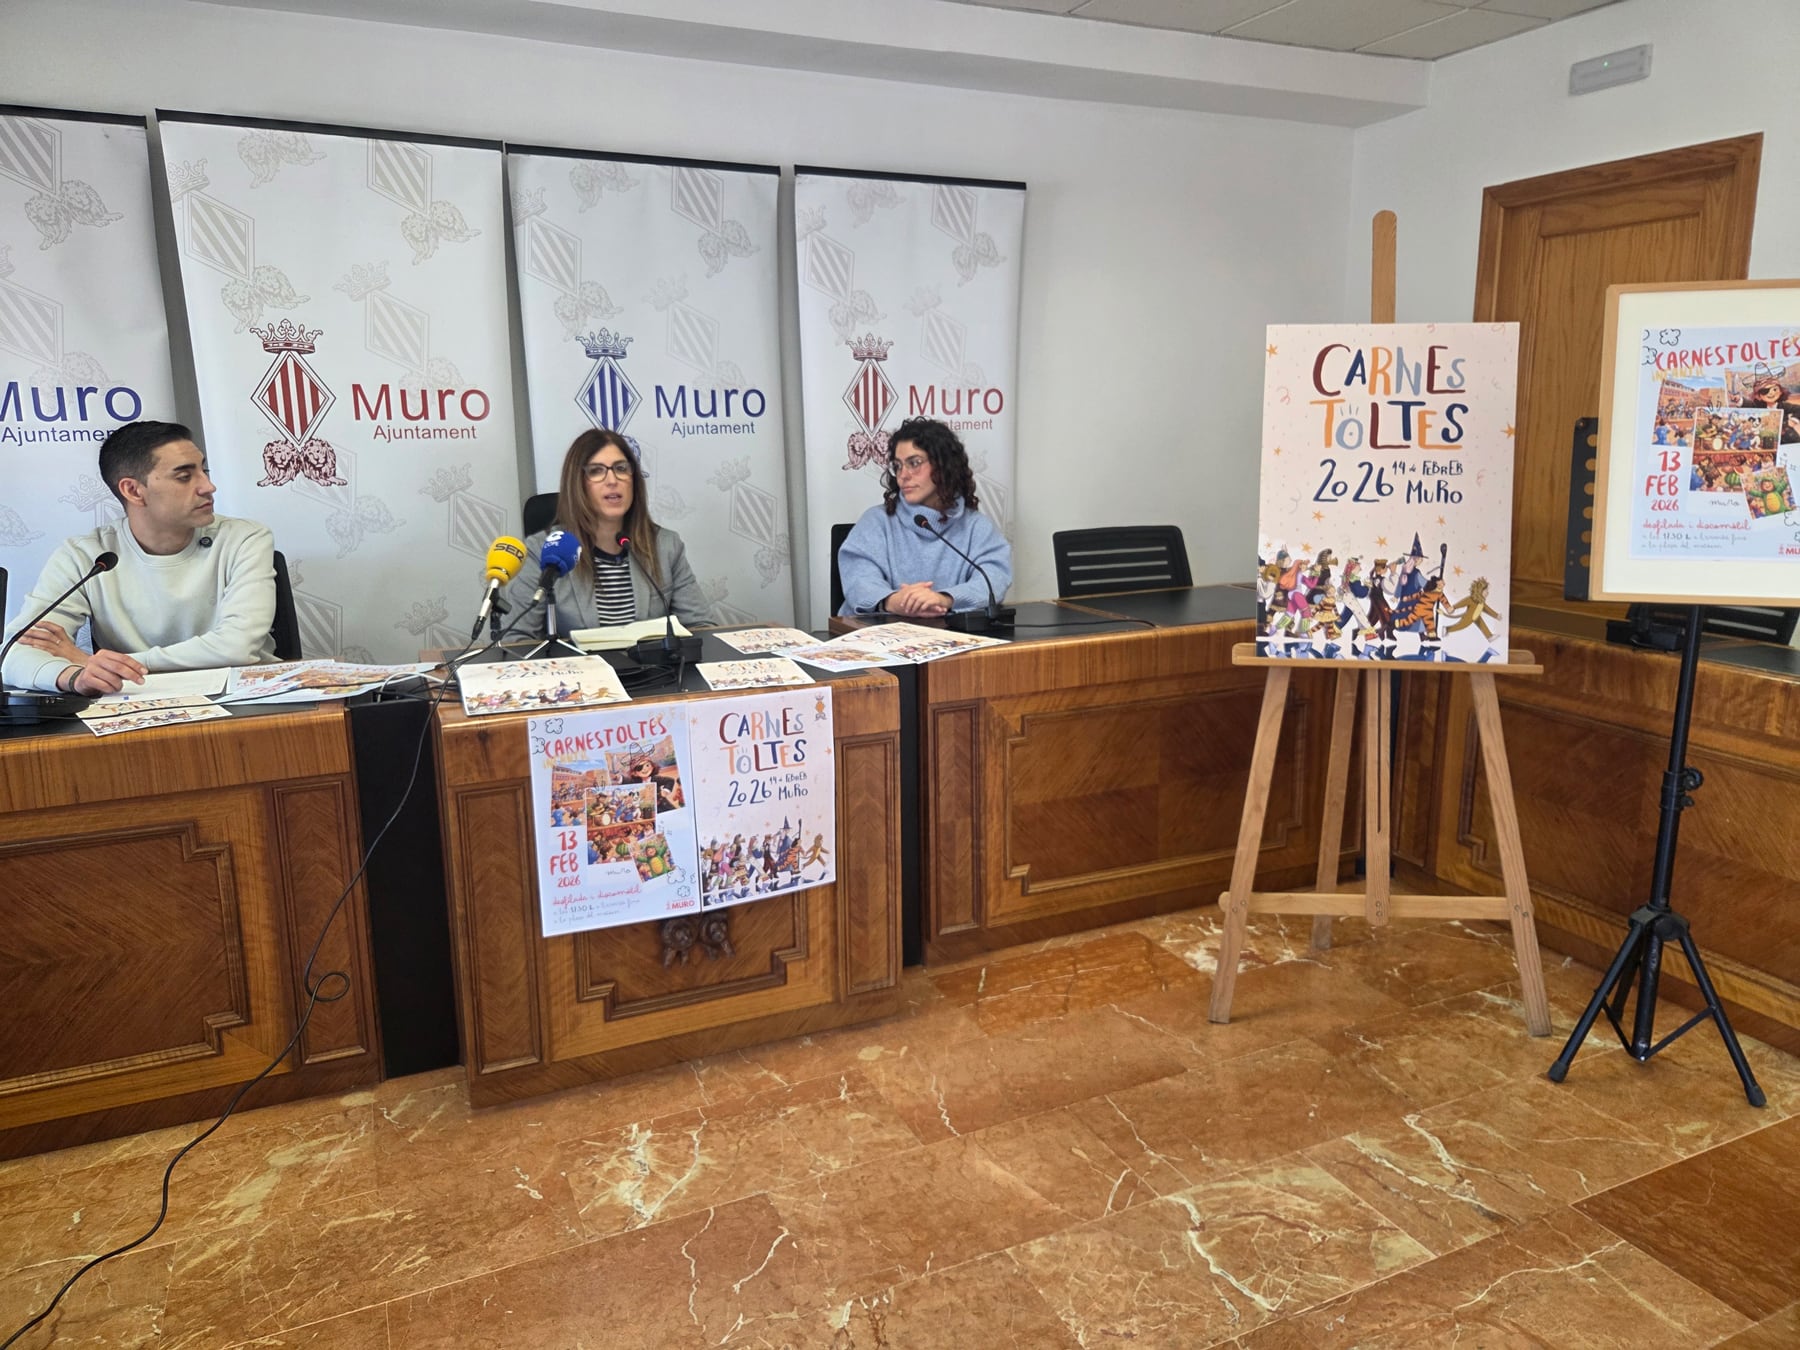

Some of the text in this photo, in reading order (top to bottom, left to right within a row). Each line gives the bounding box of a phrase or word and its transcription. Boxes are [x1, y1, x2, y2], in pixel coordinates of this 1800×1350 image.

[1312, 343, 1466, 397] CARNES
[352, 383, 490, 421] Muro
[655, 385, 766, 418] Muro
[909, 384, 1004, 416] Muro
[373, 424, 477, 443] Ajuntament
[671, 421, 755, 438] Ajuntament
[1658, 451, 1681, 472] 13
[1312, 458, 1394, 503] 2026
[1645, 474, 1679, 497] FEB
[1651, 499, 1680, 512] 2026
[544, 716, 668, 759] CARNESTOLTES
[719, 707, 805, 745] CARNES
[728, 778, 772, 808] 2026
[557, 830, 578, 851] 13
[549, 853, 579, 876] FEB
[557, 874, 581, 888] 2026
